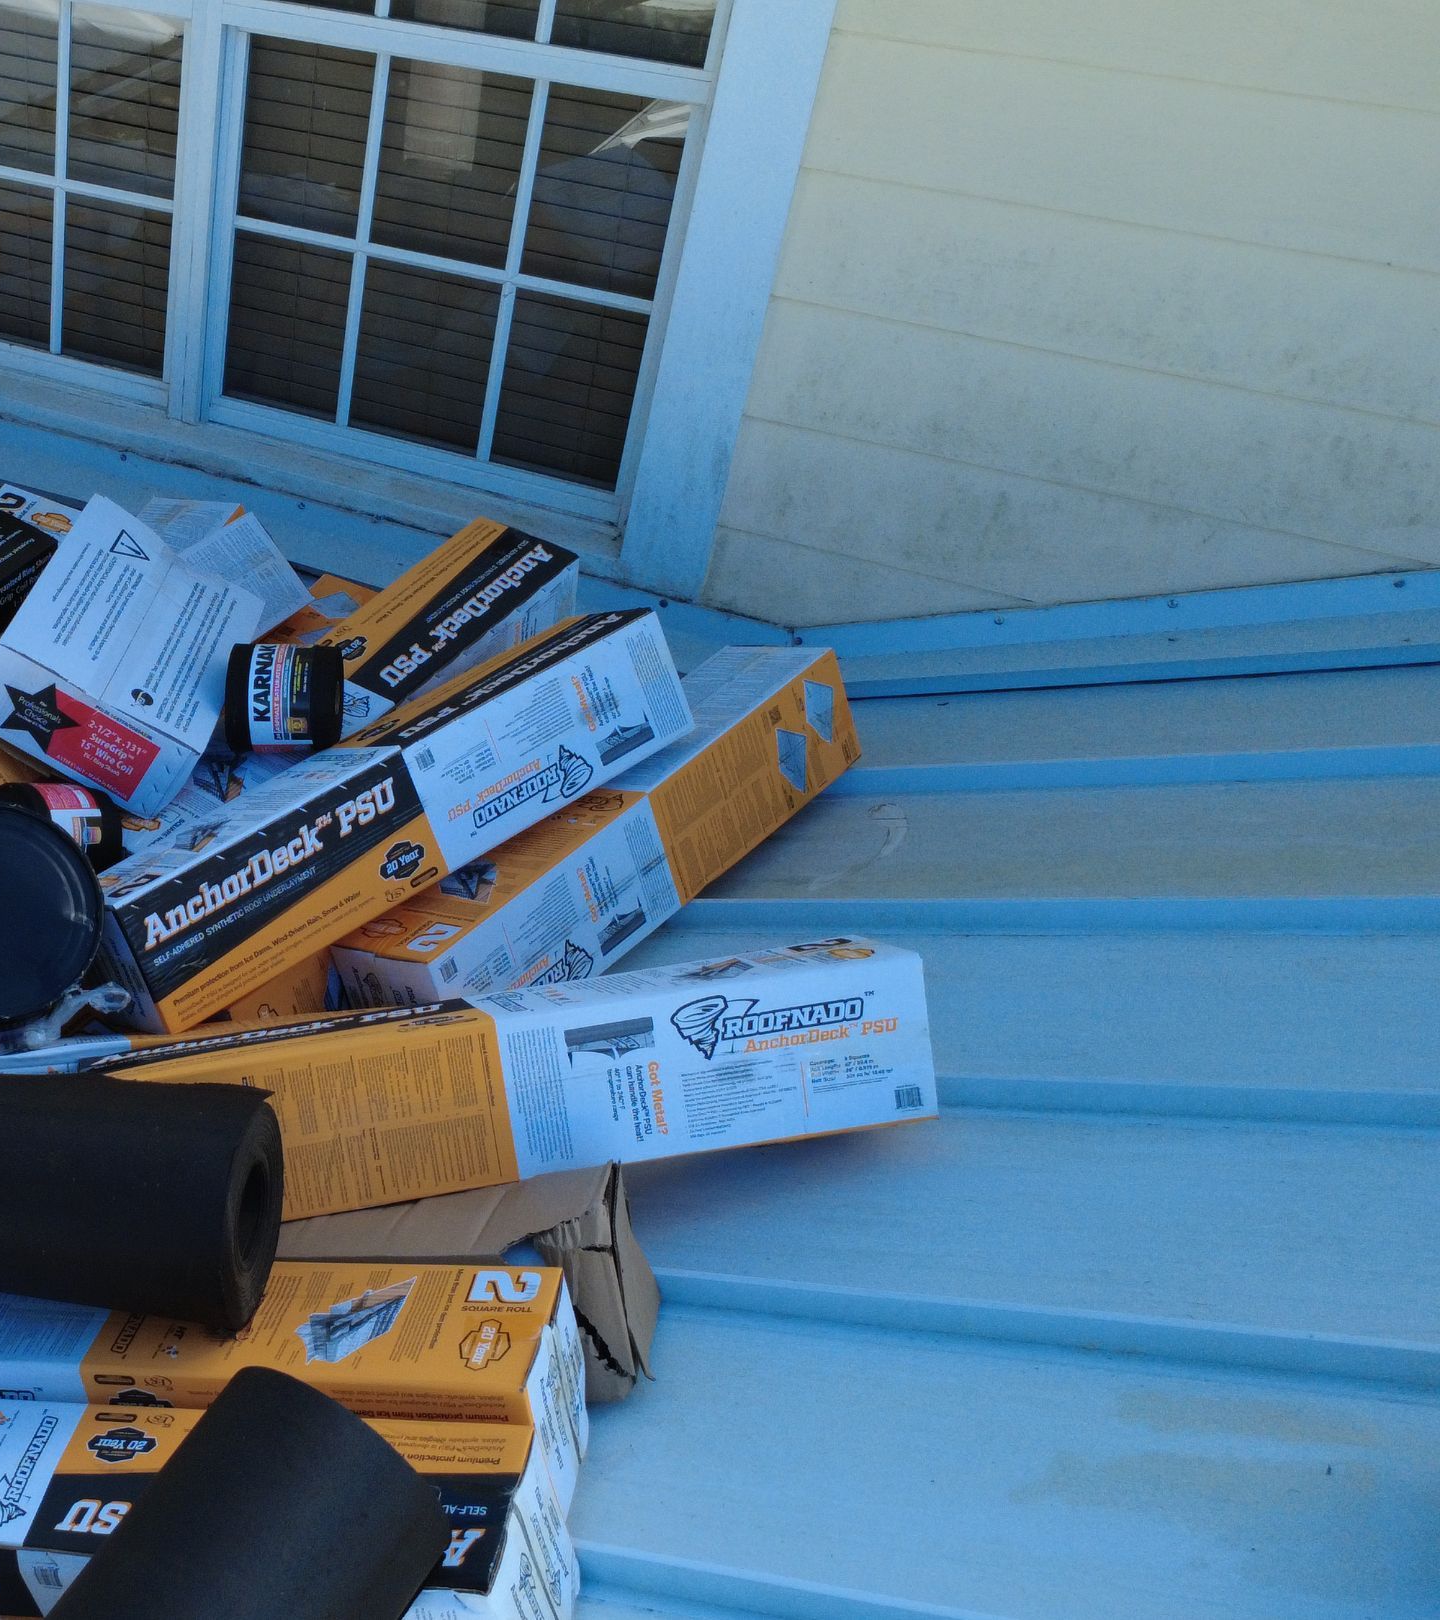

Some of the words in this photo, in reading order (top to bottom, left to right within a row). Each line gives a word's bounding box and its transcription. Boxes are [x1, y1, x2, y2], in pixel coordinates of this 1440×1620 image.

[348, 637, 361, 650] 20
[376, 637, 434, 690] PSU
[249, 642, 278, 723] KARNAK
[579, 671, 589, 686] PSU
[569, 674, 589, 711] Metal?
[16, 694, 63, 726] Professionals
[22, 707, 49, 727] Choice
[396, 701, 459, 740] PSU
[93, 747, 117, 765] Wire
[113, 759, 135, 776] Coil
[443, 798, 473, 822] PSU
[129, 811, 345, 952] AnchorDeck™
[325, 775, 407, 839] PSU
[381, 857, 402, 876] 20
[396, 845, 423, 867] Year
[151, 930, 206, 967] SELF-ADHERED
[204, 907, 246, 937] SYNTHETIC
[241, 895, 265, 915] ROOF
[260, 864, 320, 904] UNDERLAYMENT
[402, 912, 464, 961] 2
[358, 1002, 445, 1023] PSU
[741, 1021, 859, 1054] AnchorDeck™
[859, 1016, 900, 1037] PSU
[624, 1065, 634, 1080] can
[646, 1060, 662, 1087] Got
[627, 1080, 639, 1107] handle
[634, 1063, 650, 1117] AnchorDeck™
[642, 1117, 653, 1135] PSU
[631, 1107, 640, 1121] the
[650, 1088, 669, 1135] Metal?
[633, 1121, 644, 1142] heat!
[465, 1269, 542, 1306] 2
[459, 1304, 504, 1314] SQUARE
[506, 1303, 535, 1313] ROLL
[481, 1321, 498, 1340] 20
[470, 1338, 494, 1366] Year
[376, 1410, 390, 1418] Ice
[391, 1410, 414, 1418] from
[415, 1411, 463, 1420] protection
[465, 1413, 509, 1422] Premium
[94, 1437, 125, 1451] Year
[127, 1439, 147, 1452] 20
[405, 1452, 456, 1463] protection
[457, 1456, 500, 1465] Premium
[54, 1498, 132, 1535] SU
[447, 1503, 488, 1517] SELF-AD
